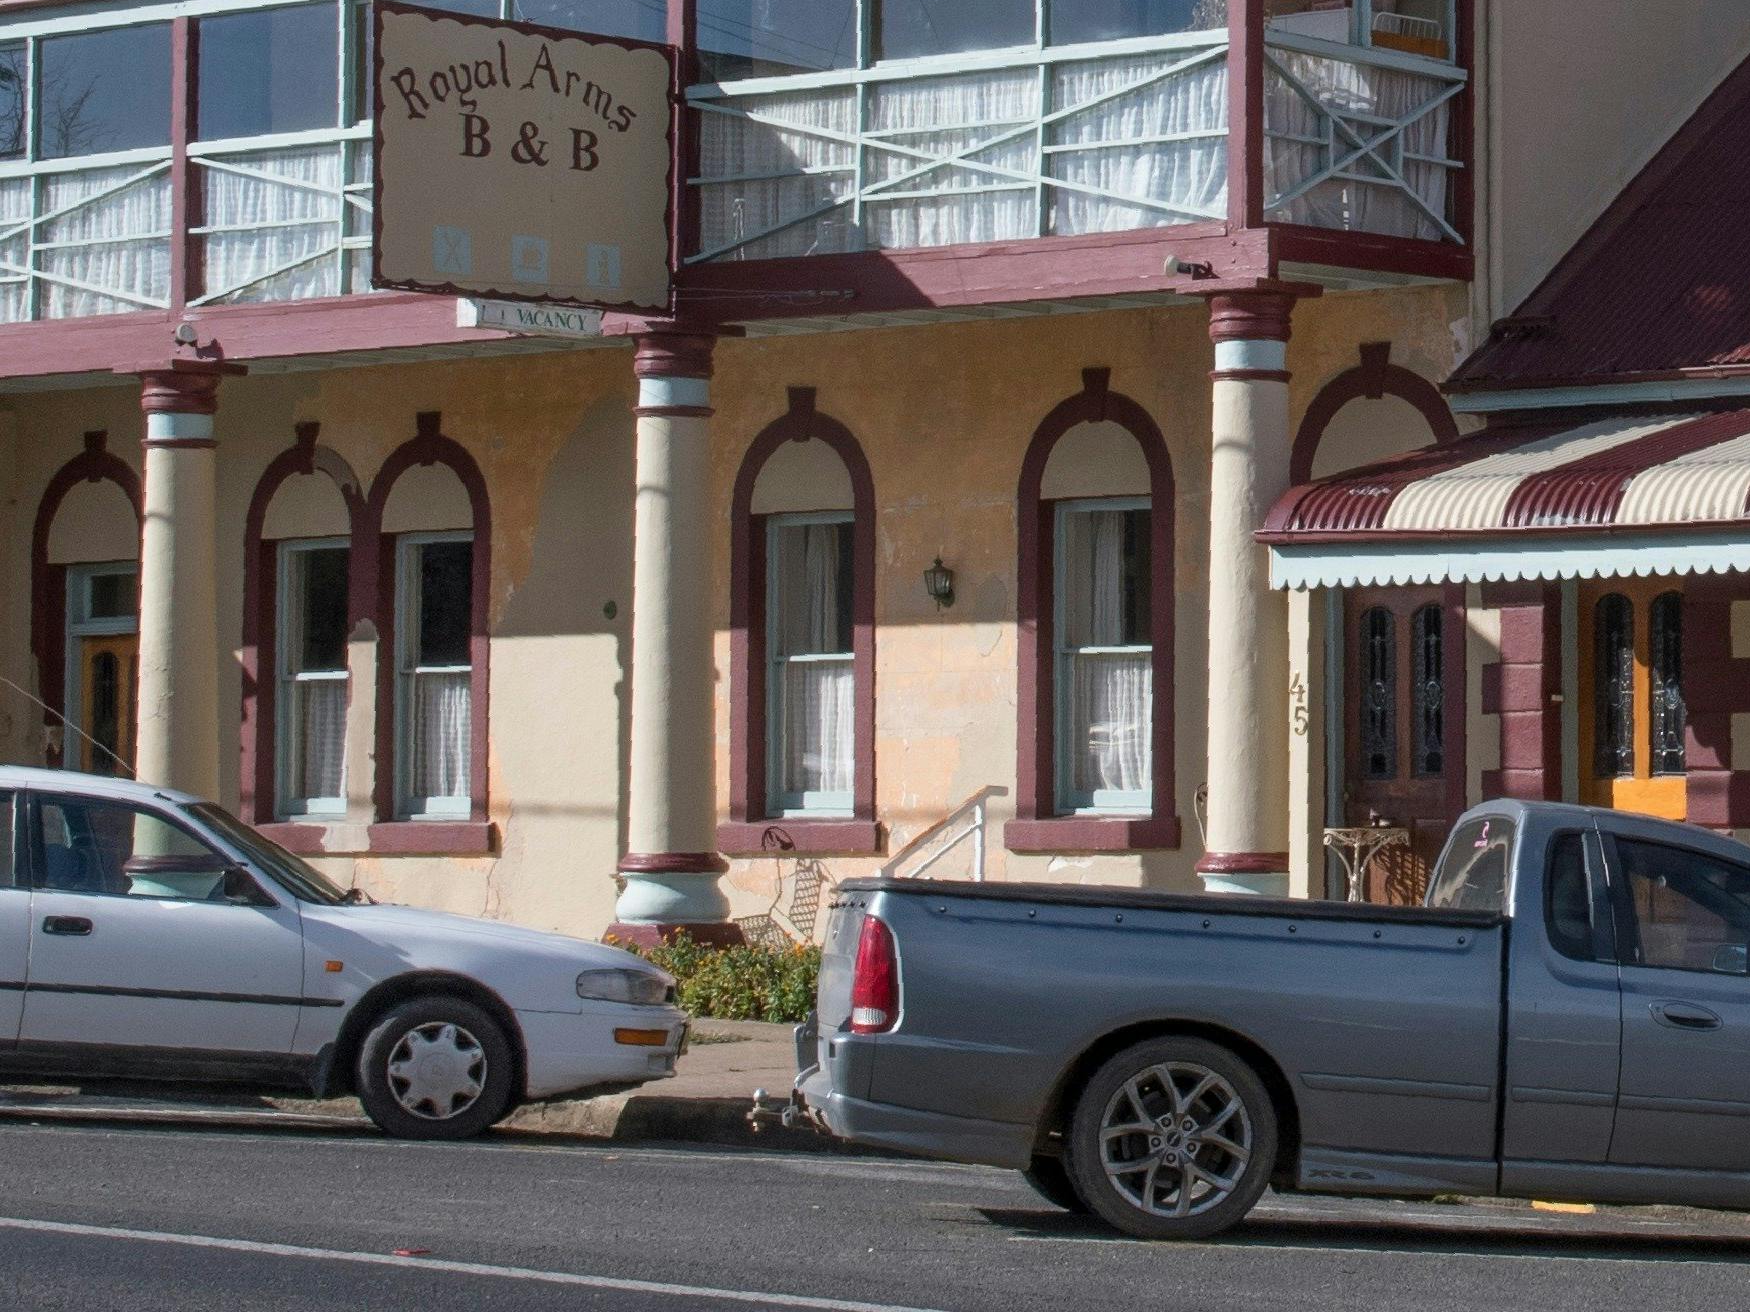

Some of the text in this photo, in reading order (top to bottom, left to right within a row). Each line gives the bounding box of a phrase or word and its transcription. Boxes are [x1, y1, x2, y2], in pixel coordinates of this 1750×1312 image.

[390, 40, 637, 133] Royal Arms
[459, 113, 601, 172] B & B
[517, 308, 588, 330] VACANCY
